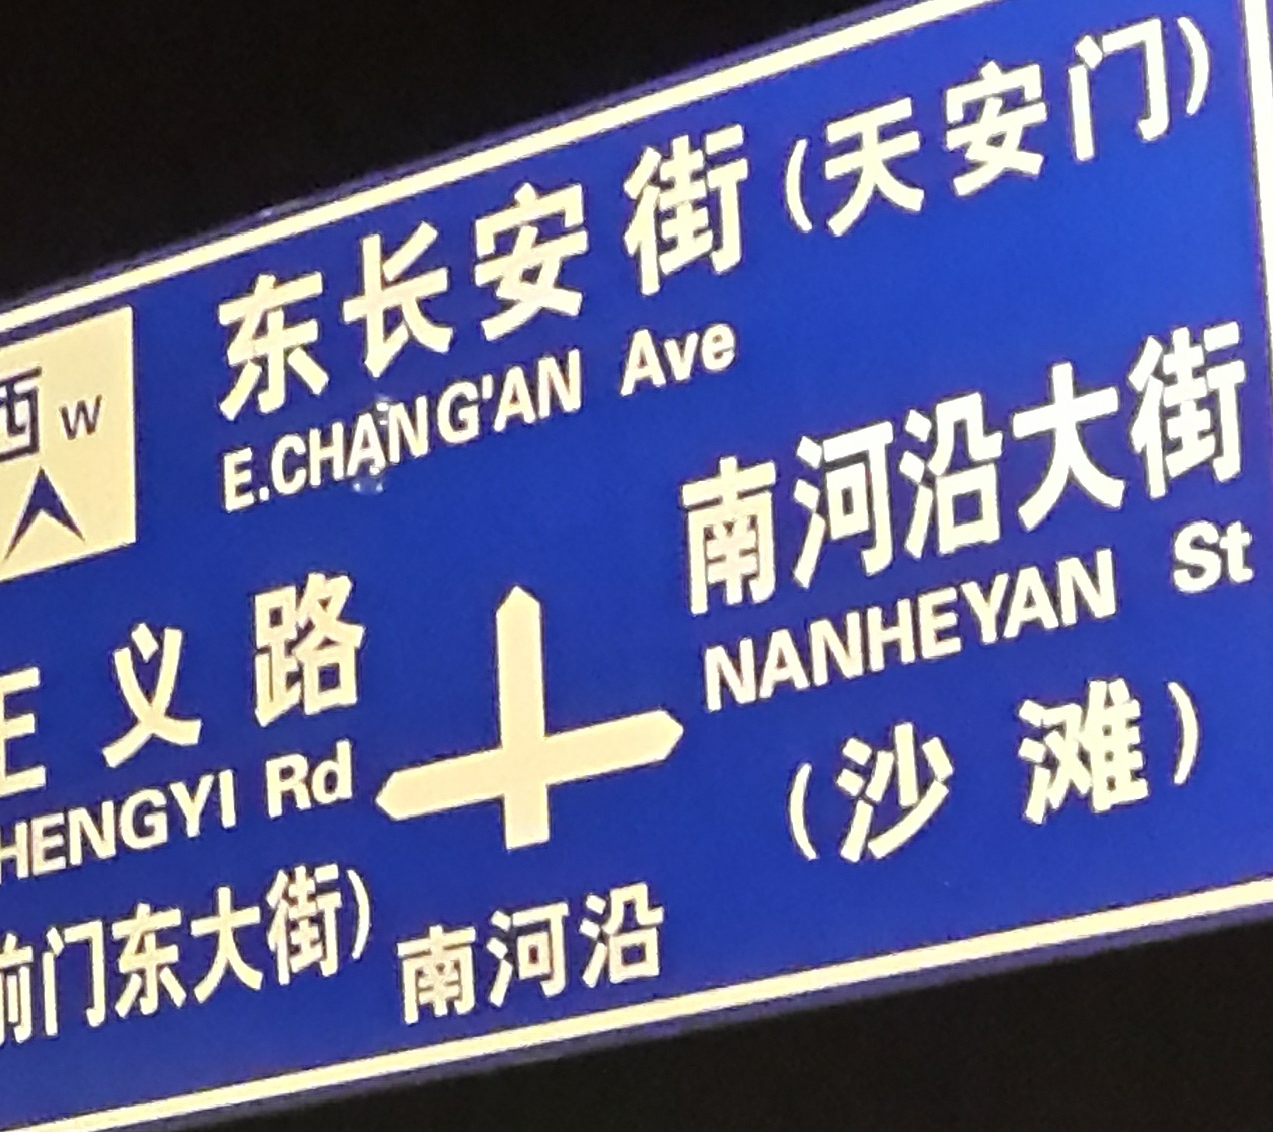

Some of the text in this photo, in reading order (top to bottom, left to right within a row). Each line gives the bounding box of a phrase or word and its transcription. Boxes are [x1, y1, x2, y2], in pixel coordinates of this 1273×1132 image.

[217, 15, 1211, 422] 东长安街 (天安门)
[58, 394, 103, 440] W
[222, 322, 738, 513] E.CHANG'AN Ave
[680, 320, 1248, 616] 南河沿大街
[703, 518, 1255, 714] NANHEYAN St
[264, 738, 354, 820] Rd
[788, 680, 1200, 864] (沙滩)
[395, 881, 666, 1026] 南河沿
